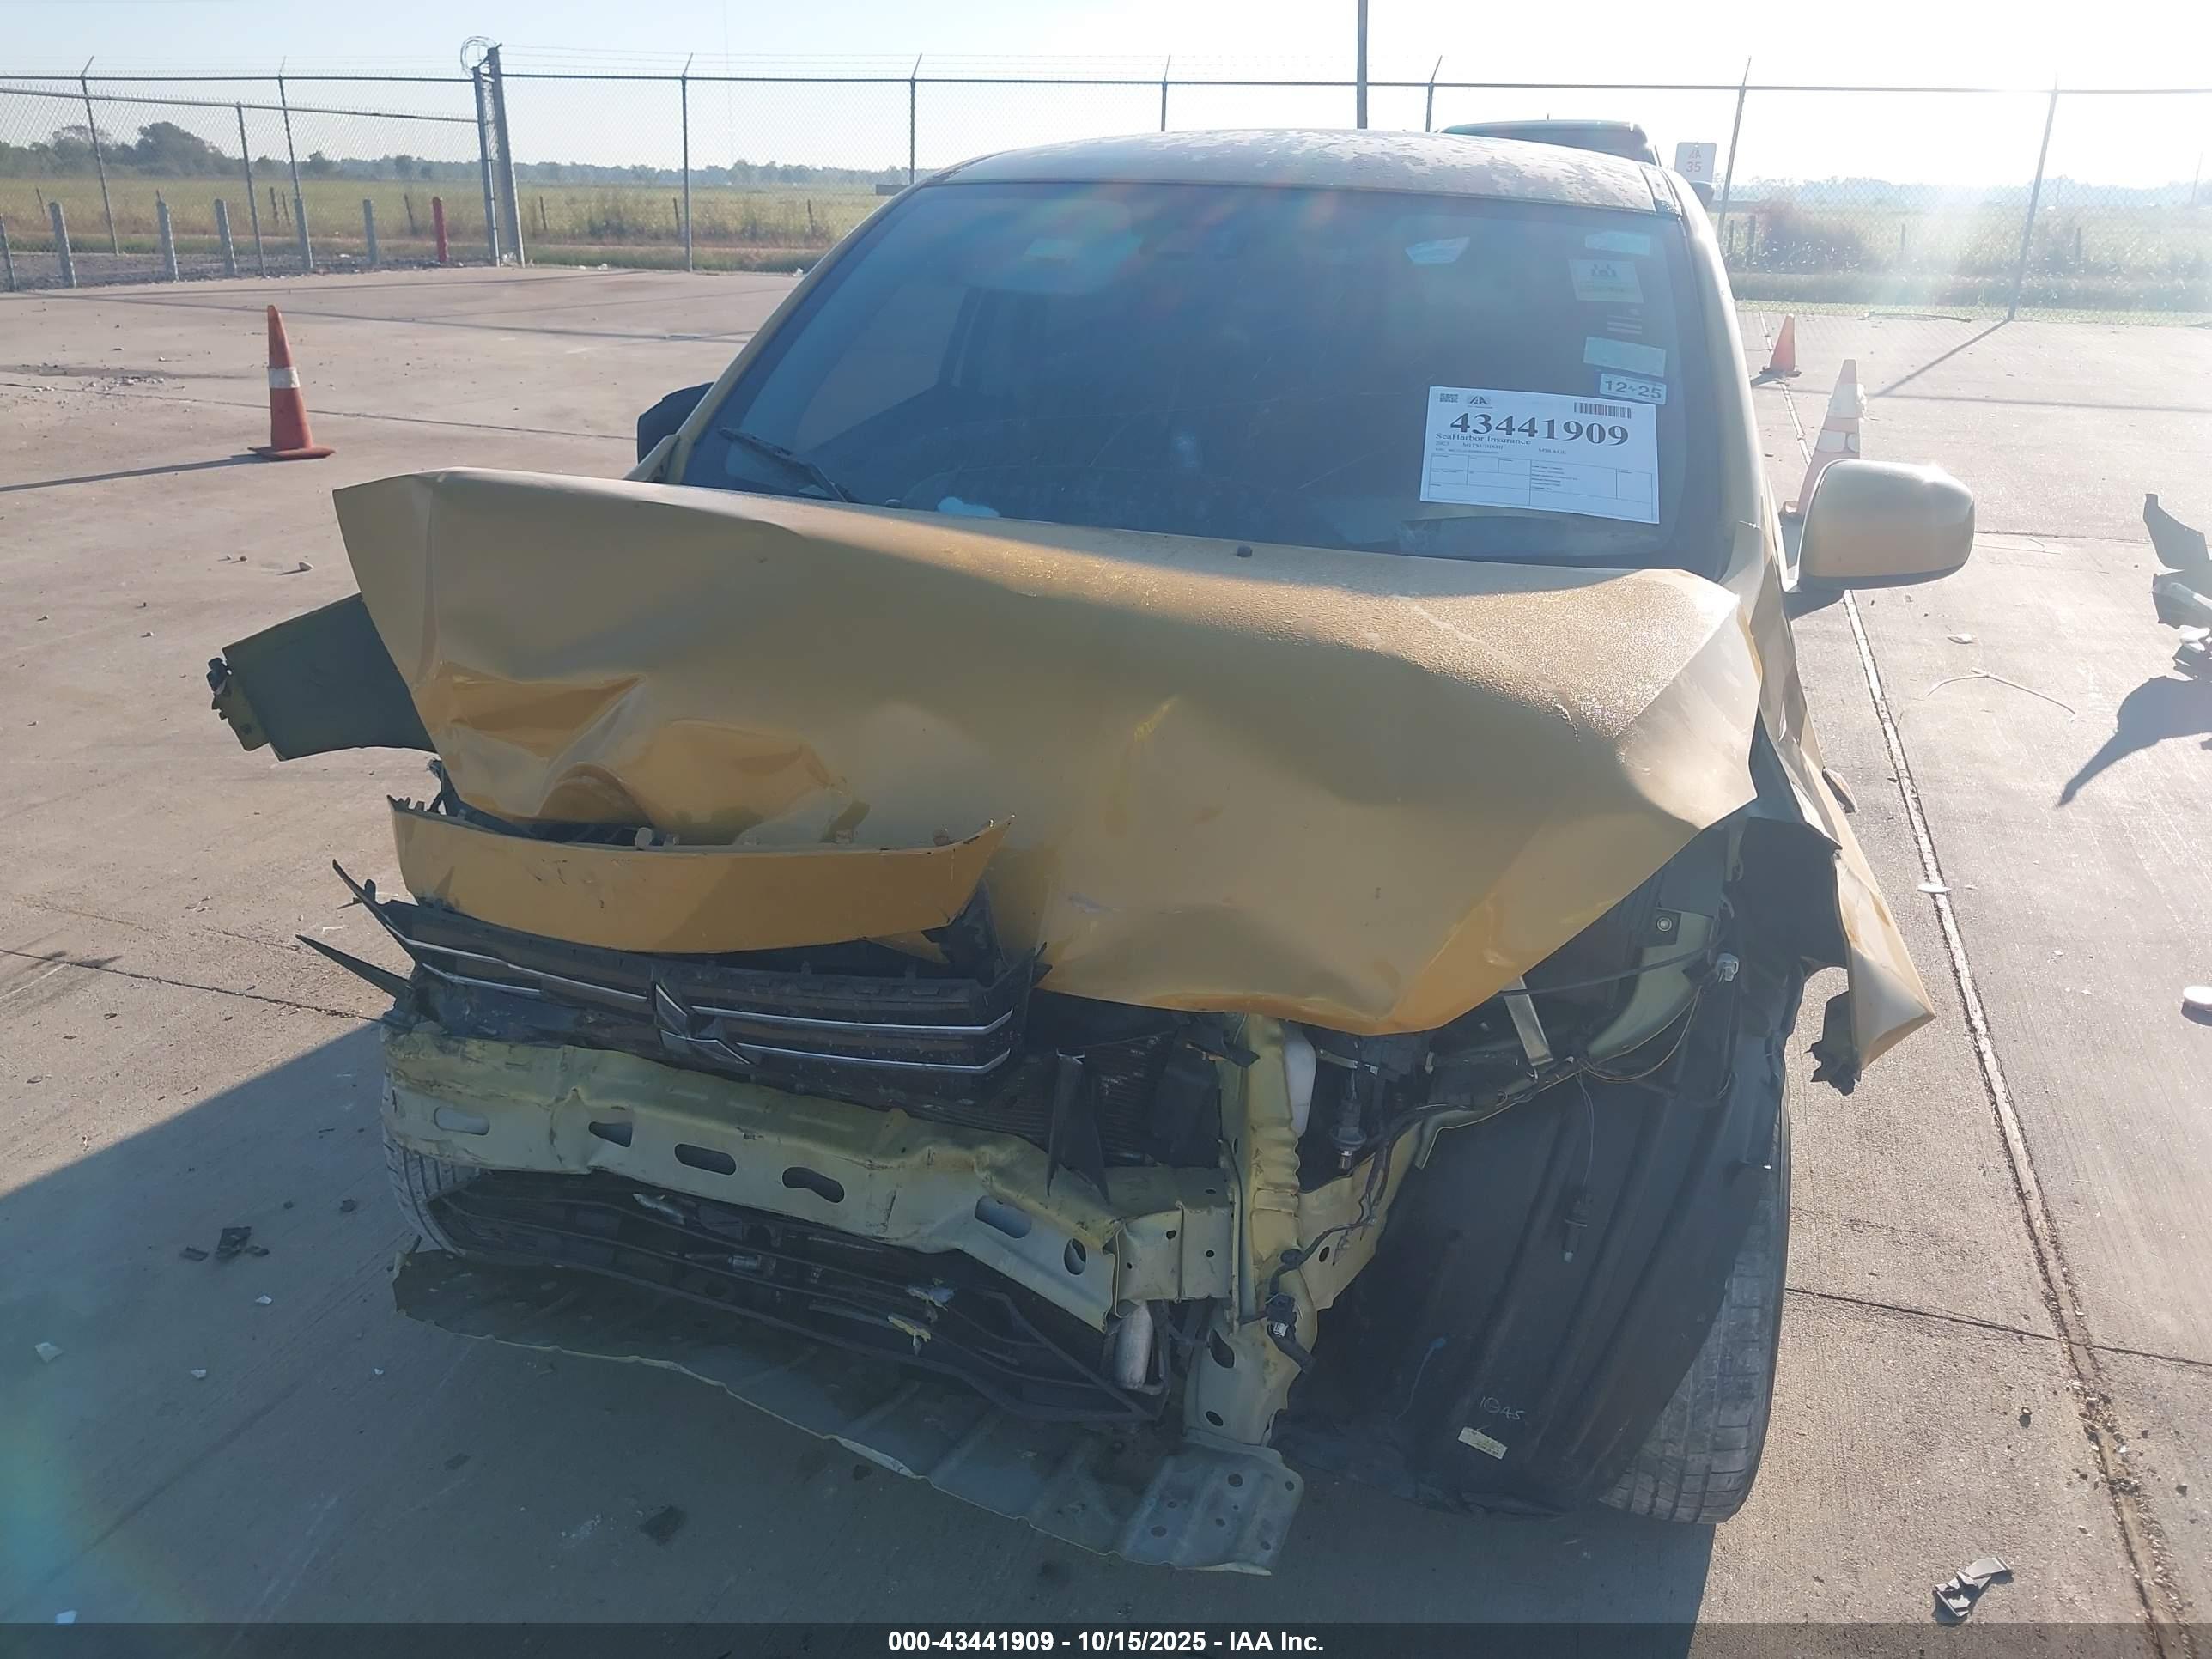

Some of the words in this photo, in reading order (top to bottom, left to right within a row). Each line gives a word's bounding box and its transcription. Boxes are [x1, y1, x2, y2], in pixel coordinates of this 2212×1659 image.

[1686, 161, 1703, 173] 35
[1449, 412, 1629, 447] 43441909
[1435, 432, 1485, 442] SeaHarbor
[1486, 434, 1532, 446] Insurance
